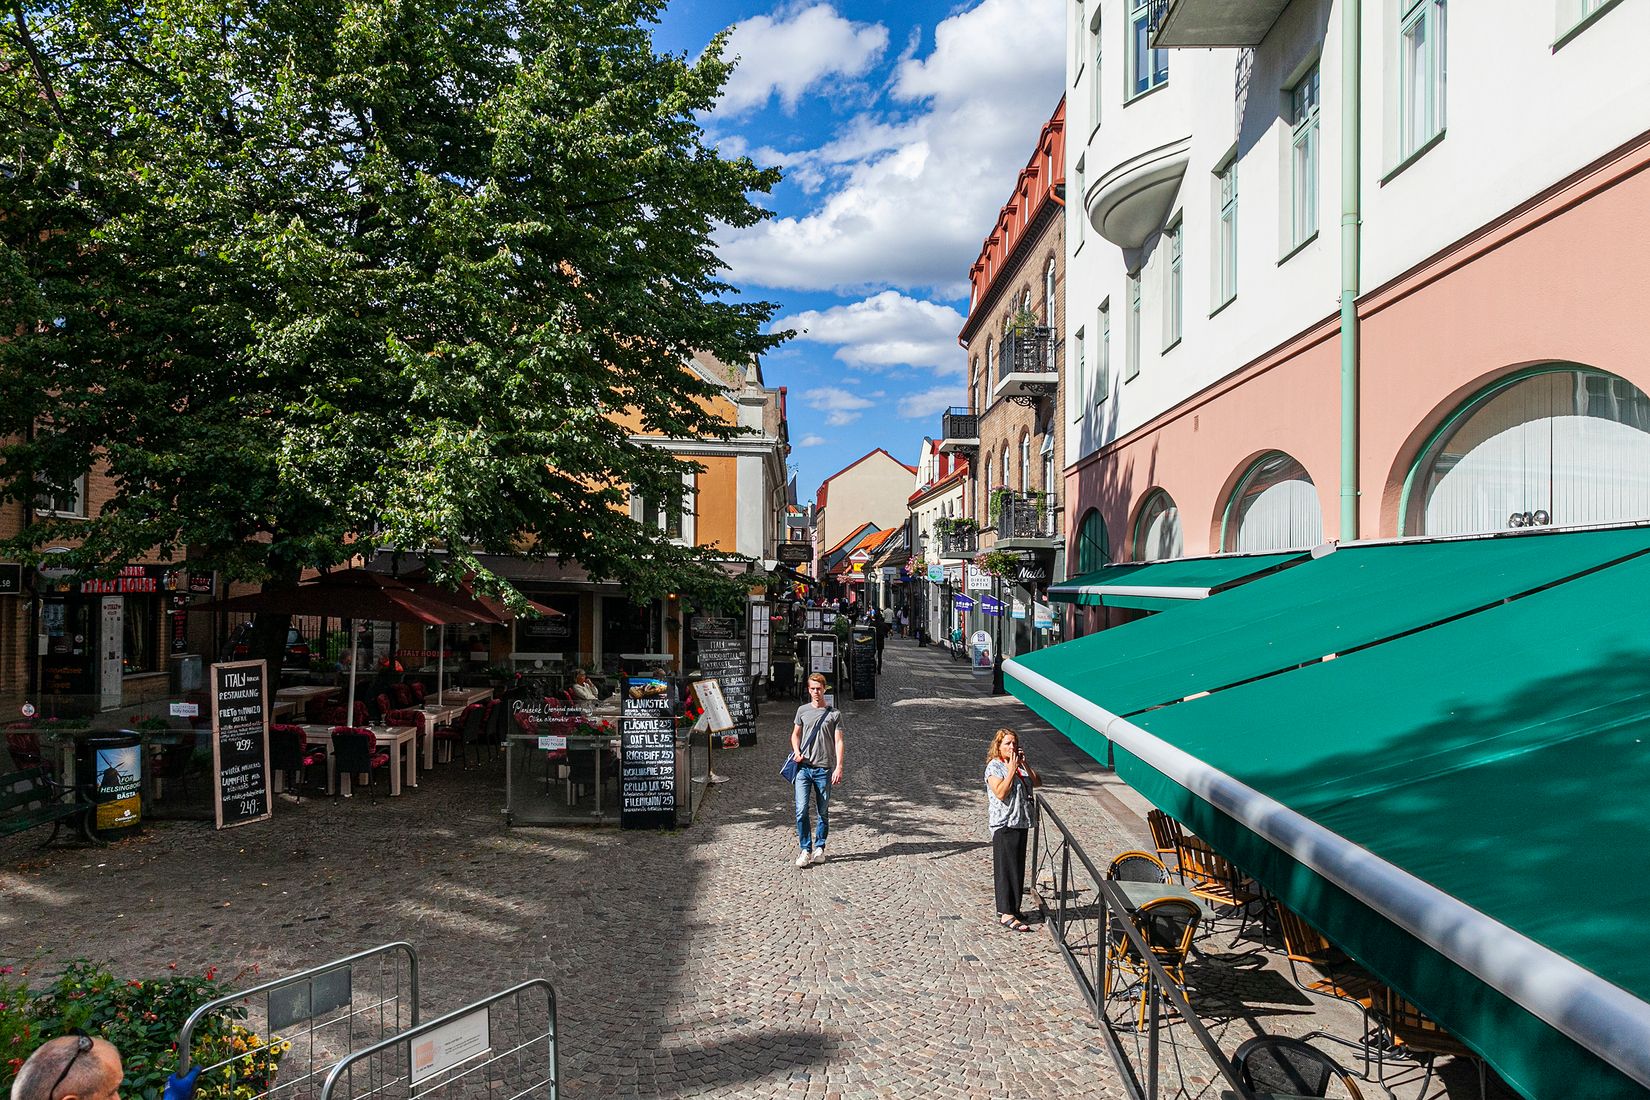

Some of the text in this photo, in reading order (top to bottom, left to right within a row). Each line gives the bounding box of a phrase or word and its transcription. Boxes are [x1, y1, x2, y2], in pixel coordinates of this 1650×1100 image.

[1019, 567, 1046, 579] Nails
[84, 577, 157, 593] ITALY HOUSE
[225, 672, 246, 688] ITALY
[219, 689, 260, 700] RESTAURANG
[625, 699, 669, 709] PLANKSTEK
[117, 791, 136, 800] BÄSTA
